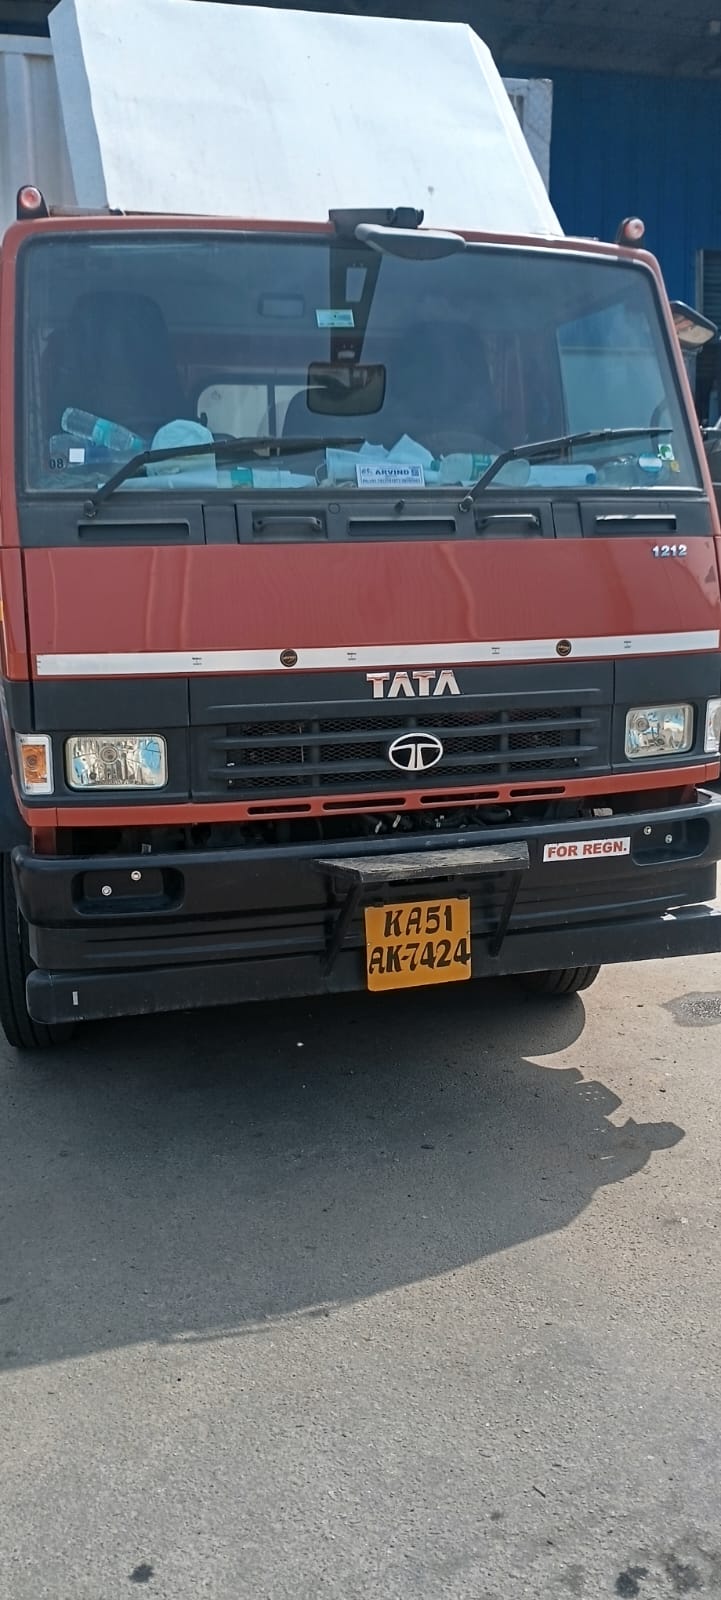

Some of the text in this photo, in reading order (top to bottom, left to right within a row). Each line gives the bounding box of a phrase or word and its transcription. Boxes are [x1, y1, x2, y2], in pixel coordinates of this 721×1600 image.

[652, 544, 688, 558] 1212
[366, 669, 461, 699] TATA
[547, 841, 627, 858] FOR REGN.
[384, 904, 453, 938] KA51
[369, 938, 471, 975] AK-7424
